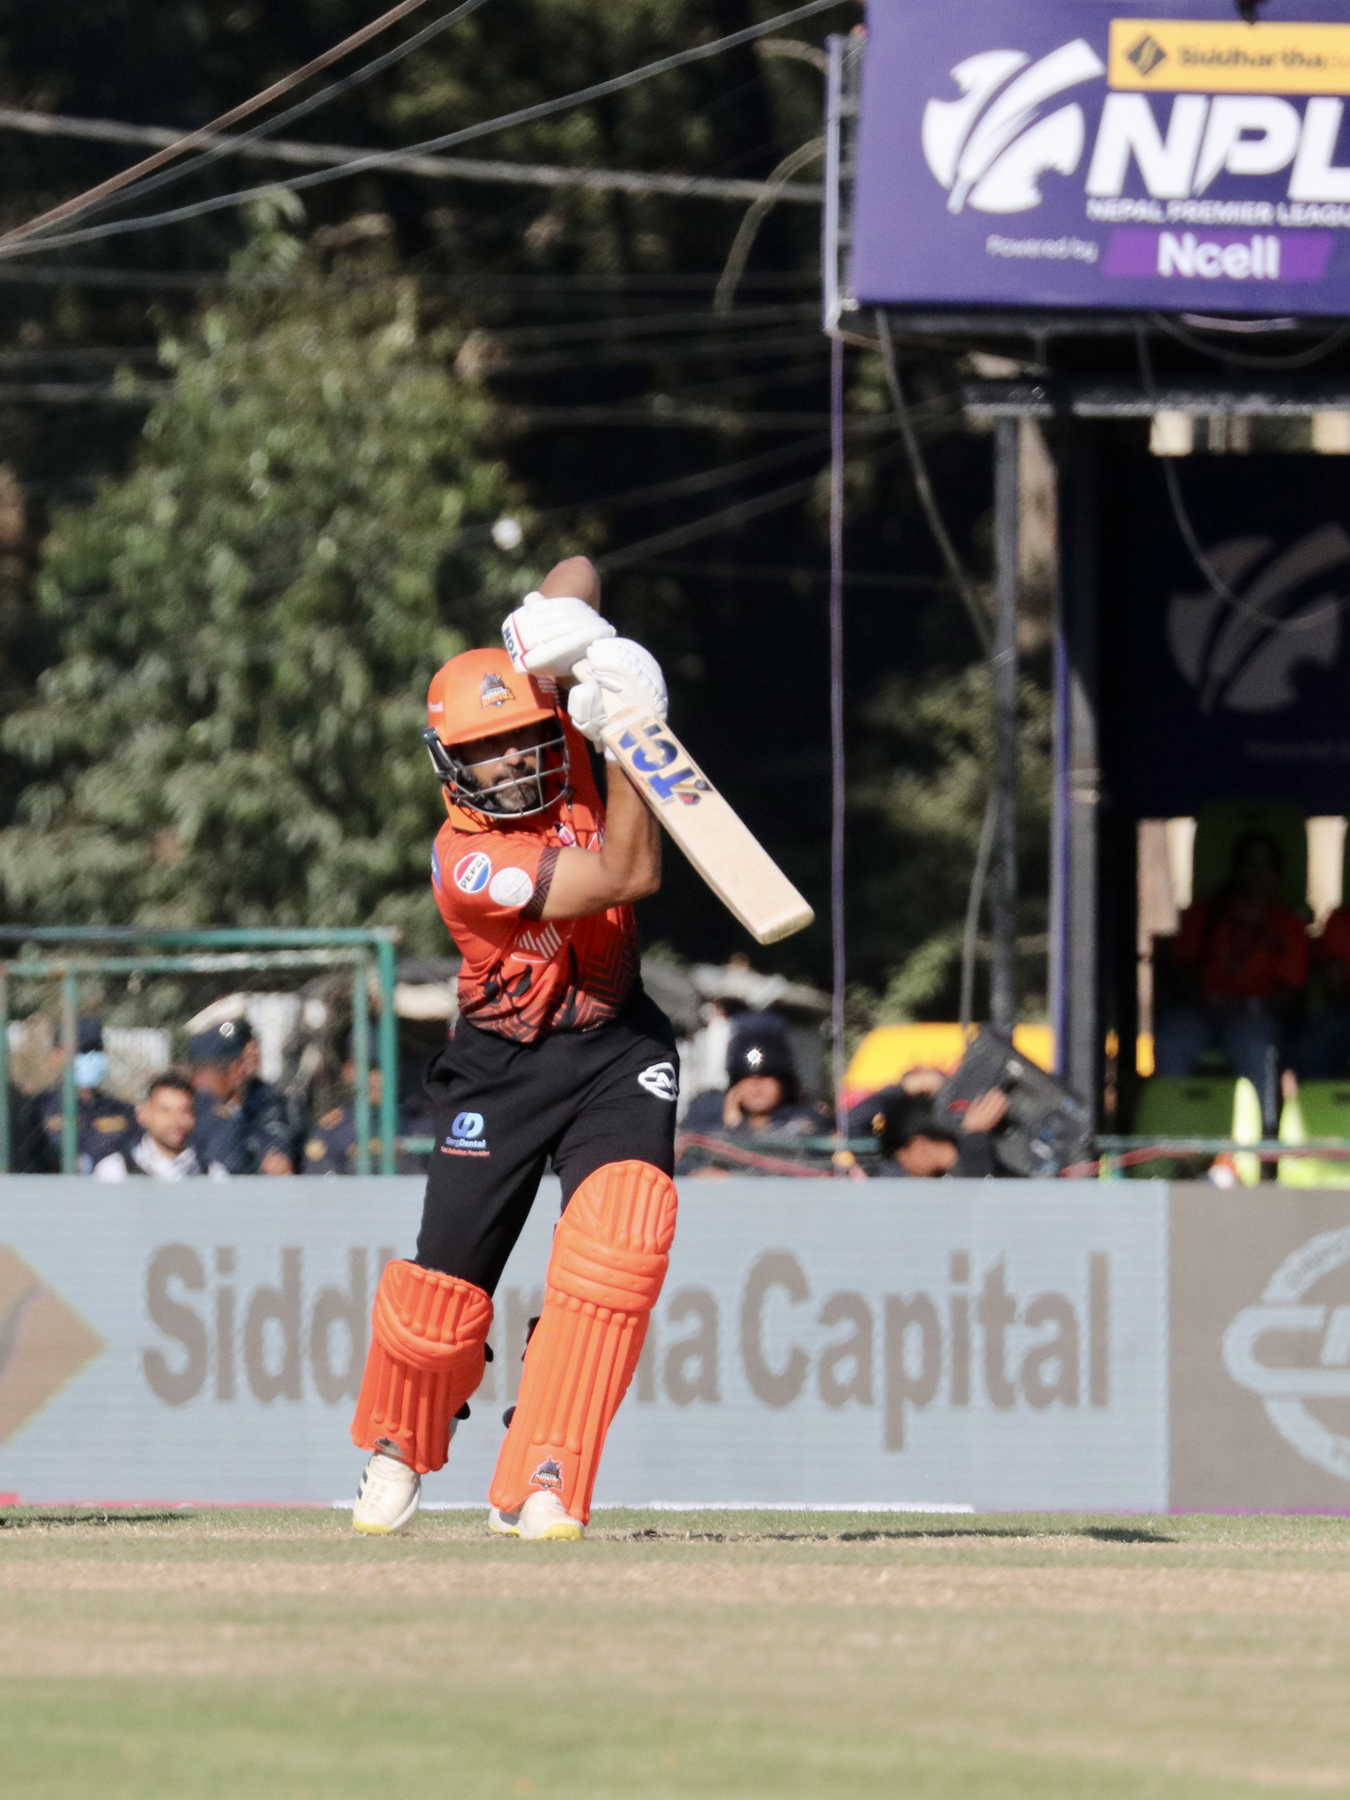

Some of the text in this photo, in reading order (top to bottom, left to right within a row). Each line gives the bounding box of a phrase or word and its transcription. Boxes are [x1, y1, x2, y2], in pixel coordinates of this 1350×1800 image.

[1085, 92, 1350, 201] NPL
[1086, 198, 1166, 223] NEPAL
[1167, 199, 1275, 227] PREMIER
[1157, 231, 1281, 280] Ncell
[460, 857, 486, 889] PEPSI
